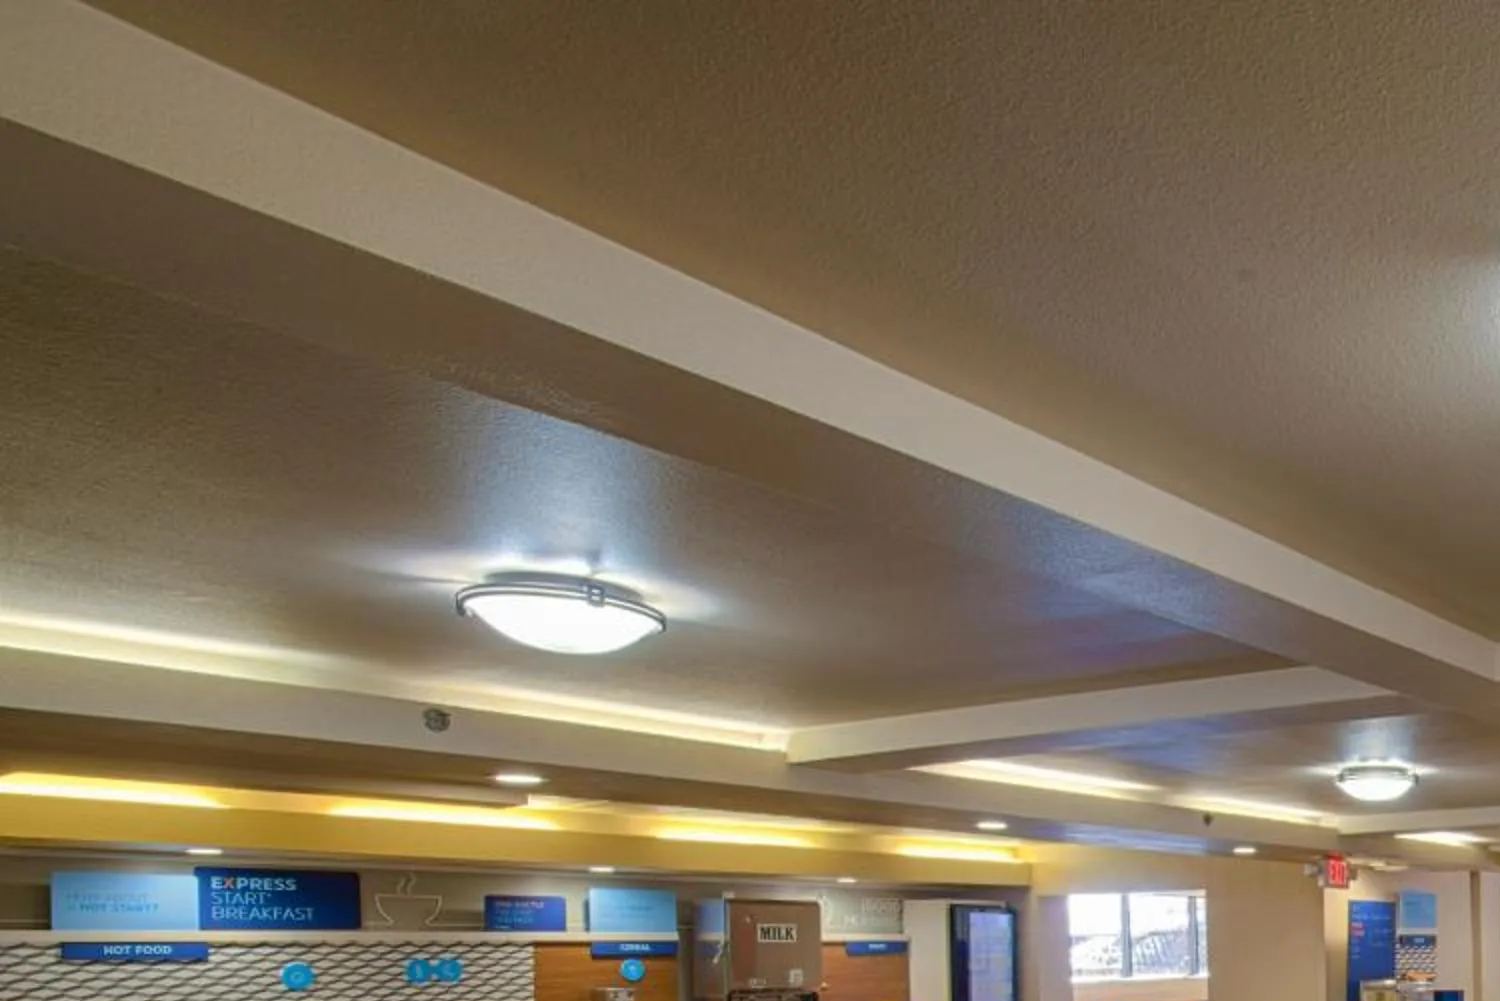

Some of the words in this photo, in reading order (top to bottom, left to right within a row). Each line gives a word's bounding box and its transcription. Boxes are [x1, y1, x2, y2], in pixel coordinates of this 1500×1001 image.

[210, 876, 297, 891] EXPRESS
[211, 906, 315, 921] BREAKFAST
[760, 926, 795, 941] MILK
[103, 945, 132, 956] HOT
[135, 945, 173, 956] FOOD
